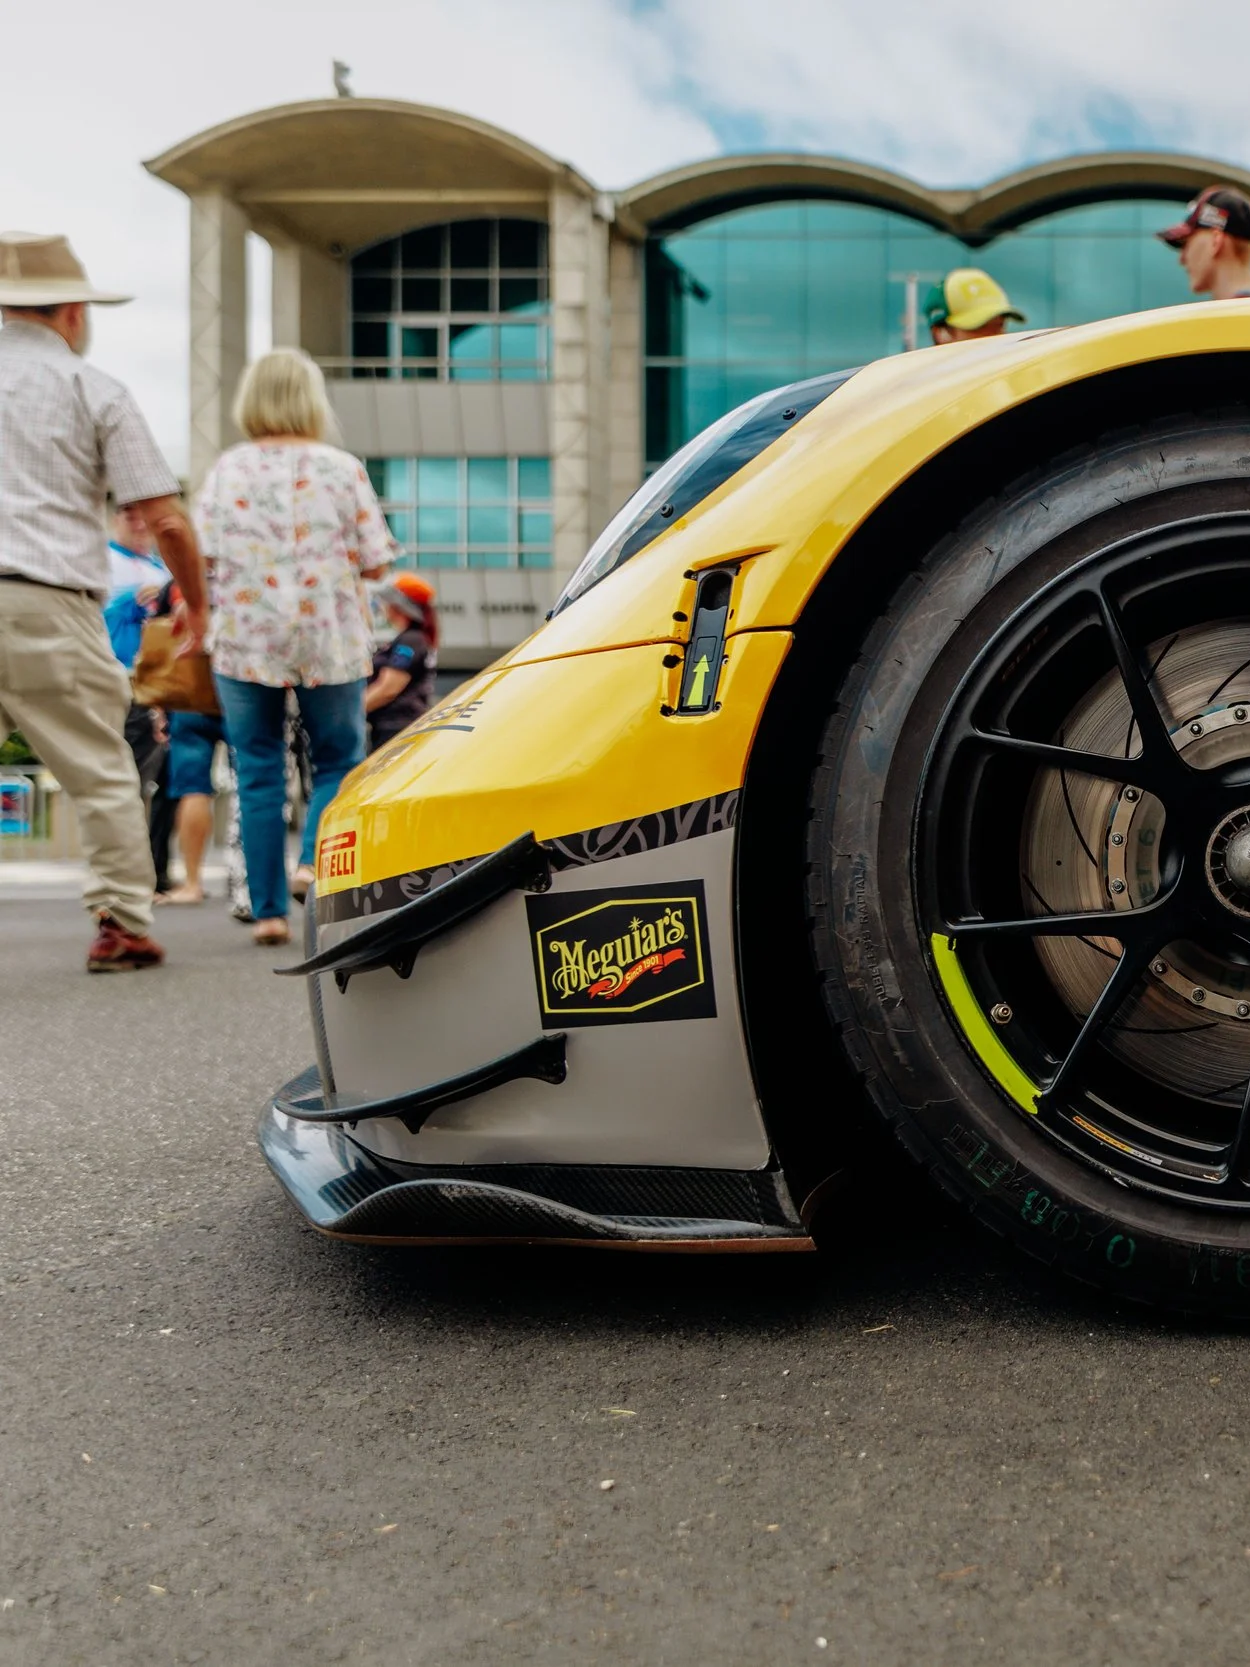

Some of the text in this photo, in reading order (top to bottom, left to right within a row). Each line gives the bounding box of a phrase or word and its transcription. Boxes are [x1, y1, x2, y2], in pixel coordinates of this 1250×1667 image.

[317, 830, 357, 881] PIRELLI
[550, 908, 685, 999] Meguiar's
[625, 955, 659, 984] Since 1901
